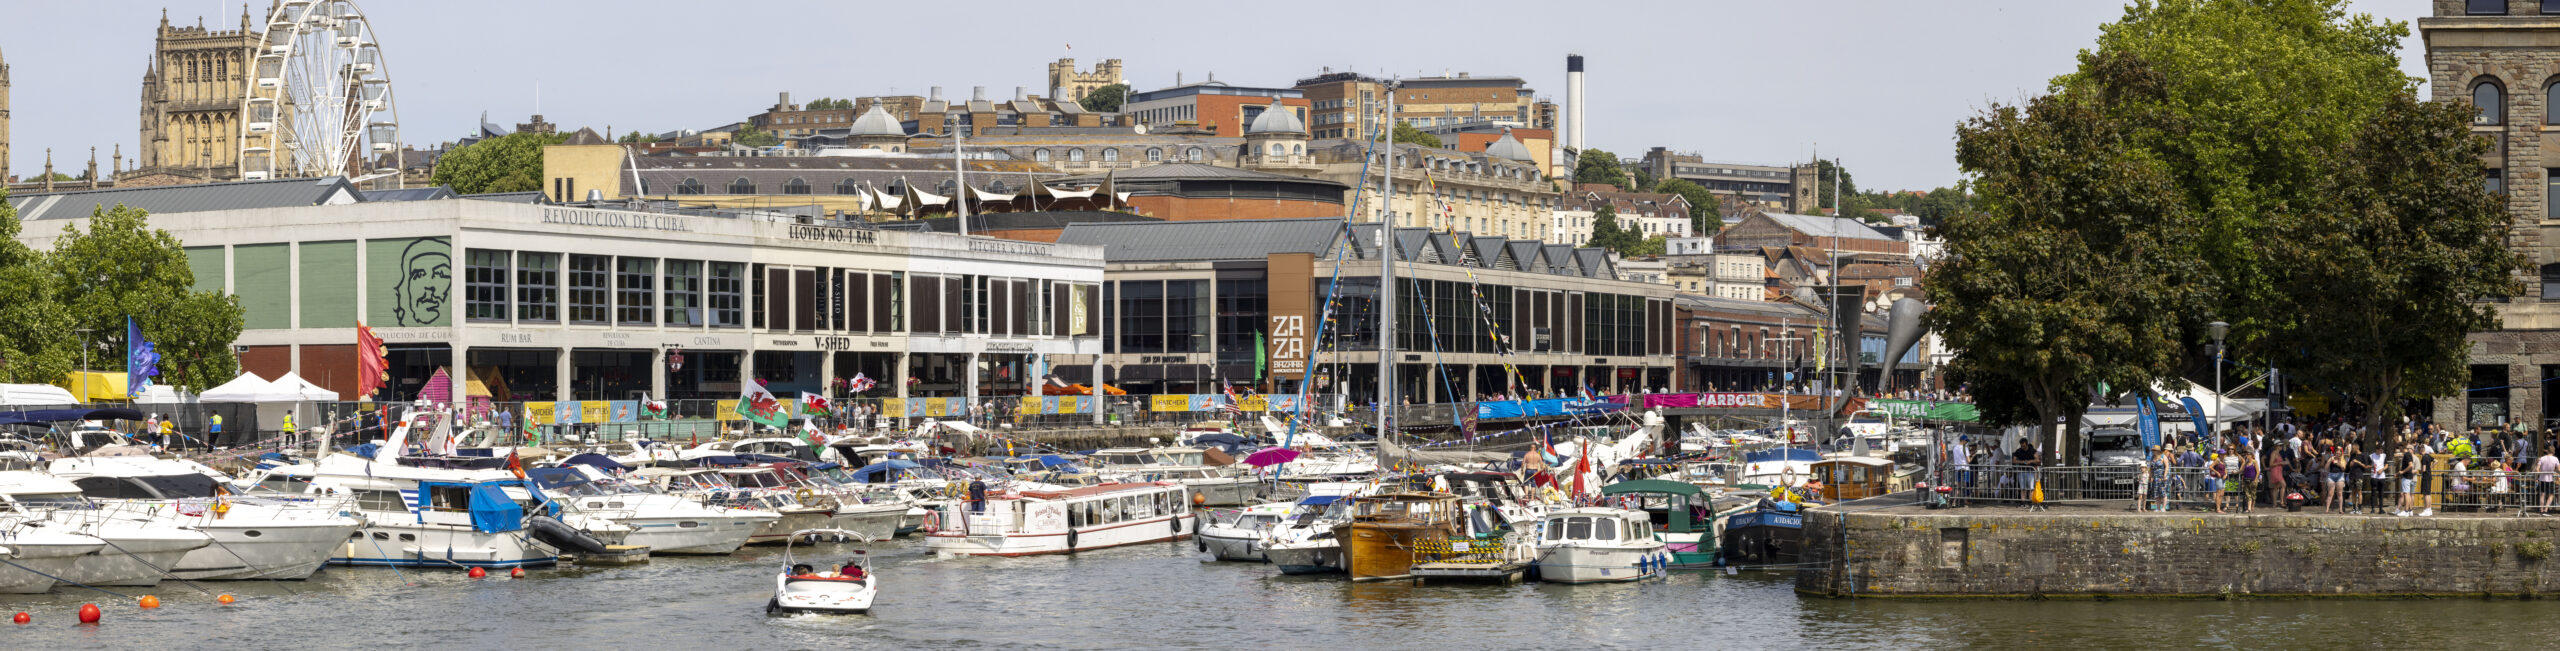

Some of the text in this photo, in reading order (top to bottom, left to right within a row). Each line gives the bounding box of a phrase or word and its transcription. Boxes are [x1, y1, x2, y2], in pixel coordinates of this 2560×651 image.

[544, 208, 686, 231] REVOLUCION DE CUBA
[789, 226, 825, 240] LLOYDS
[829, 229, 846, 242] NO.
[856, 231, 874, 244] BAR
[969, 241, 1006, 253] PITCHER
[1019, 245, 1046, 256] PIANO
[1273, 315, 1304, 336] ZA
[501, 333, 532, 343] RUM BAR
[694, 336, 720, 346] CANTINA
[814, 337, 850, 350] V-SHED
[1273, 338, 1304, 359] ZA
[1697, 393, 1765, 406] HARBOUR
